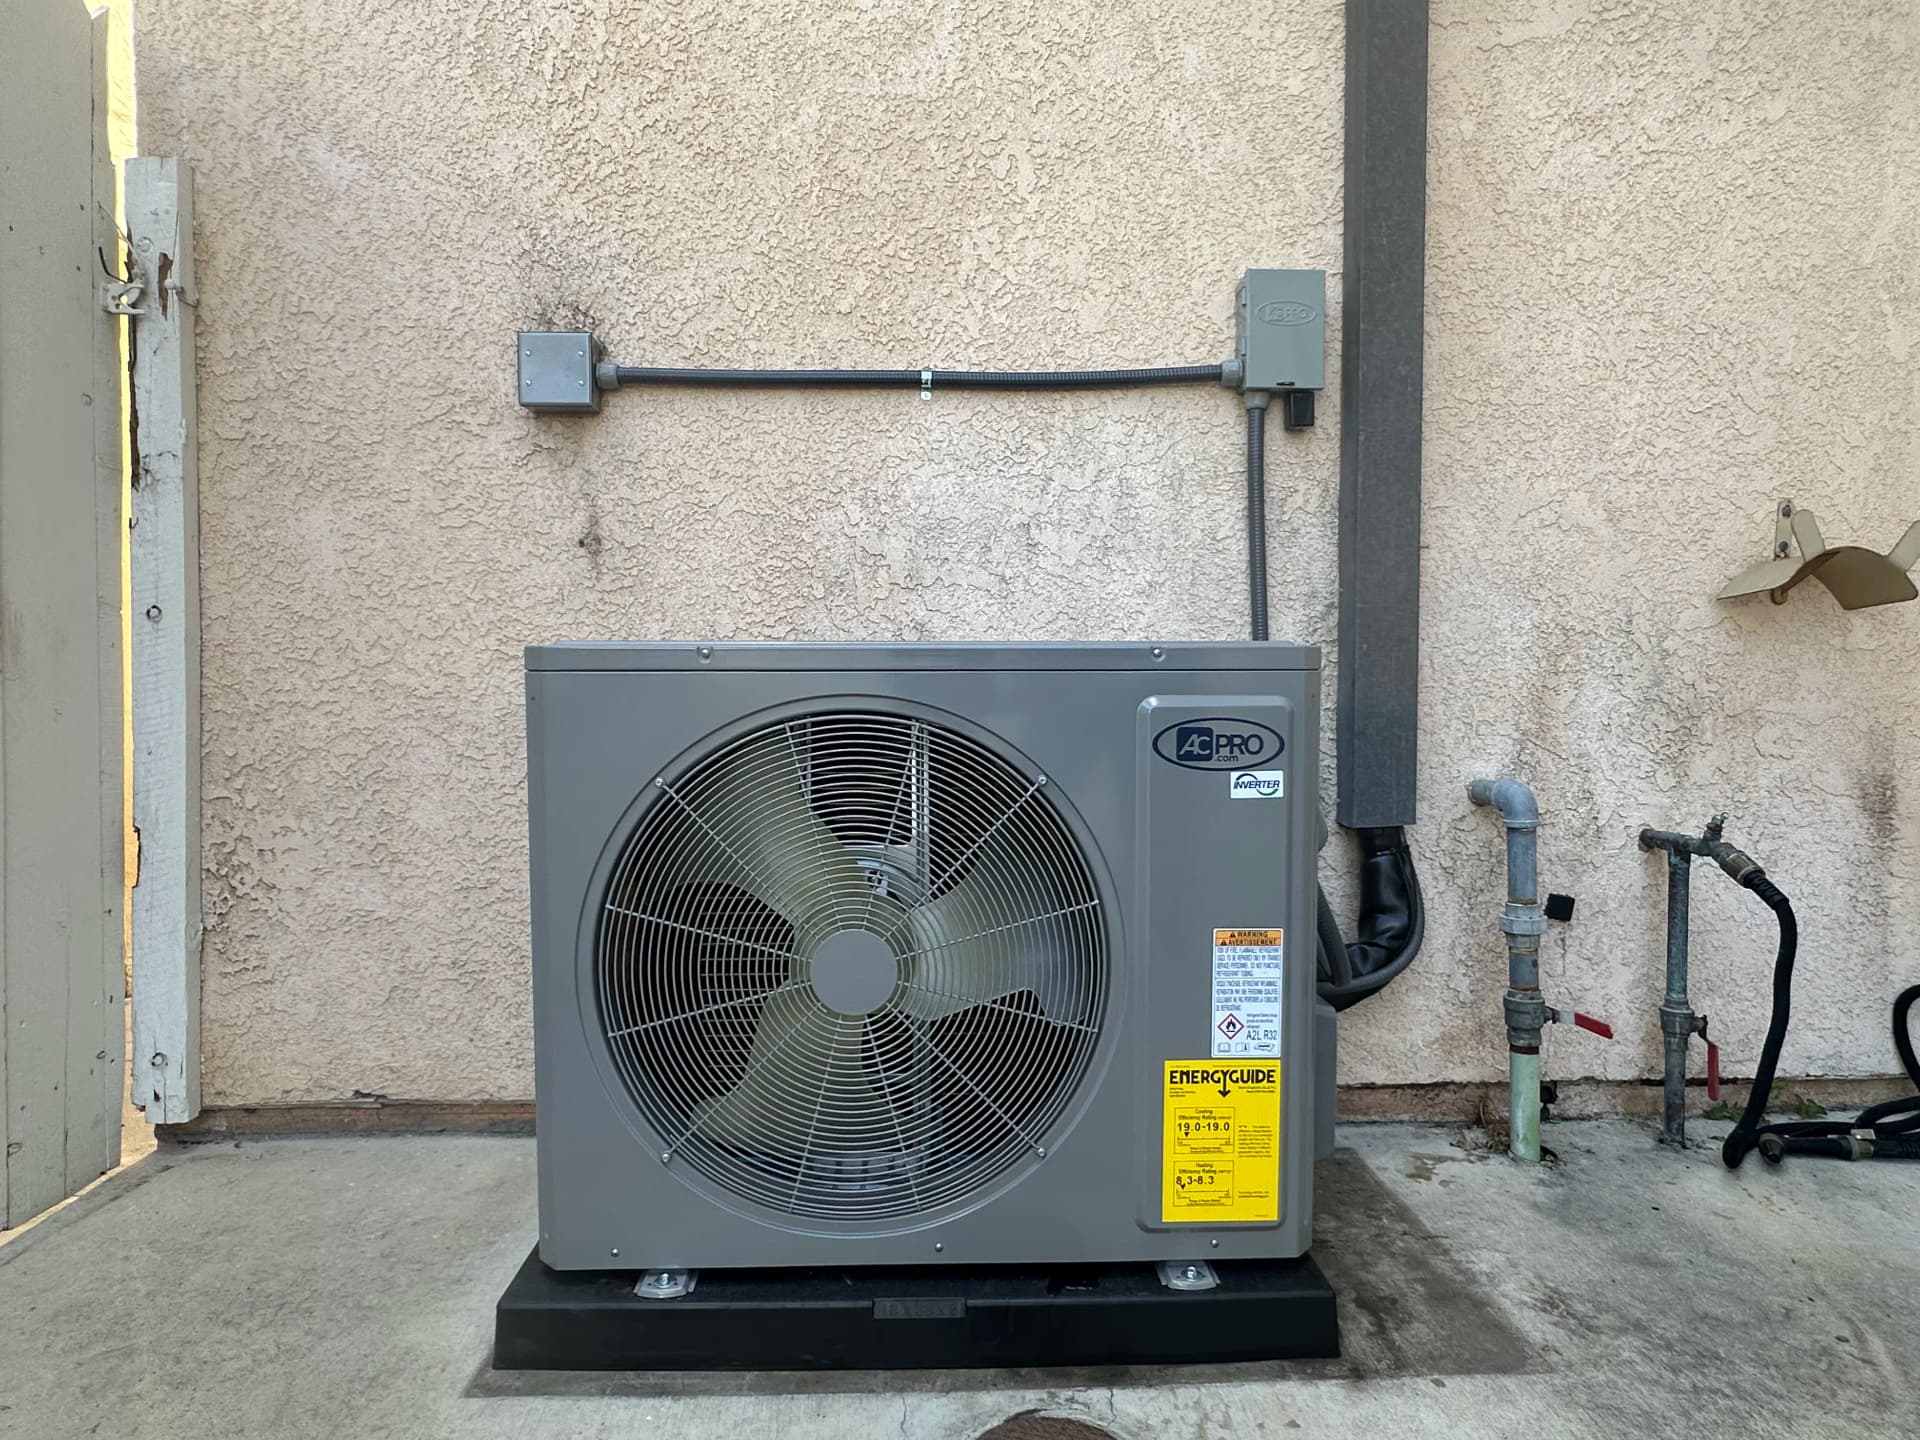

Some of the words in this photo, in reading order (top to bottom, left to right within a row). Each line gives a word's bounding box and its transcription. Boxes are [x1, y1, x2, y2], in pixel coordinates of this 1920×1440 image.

[1233, 780, 1280, 789] INVERTER
[1246, 1030, 1261, 1040] A2L
[1263, 1030, 1277, 1040] R32
[1169, 1069, 1276, 1087] ENERGYGUIDE
[1177, 1121, 1230, 1131] 19.0-19.0
[1176, 1175, 1214, 1185] 8.3-8.3
